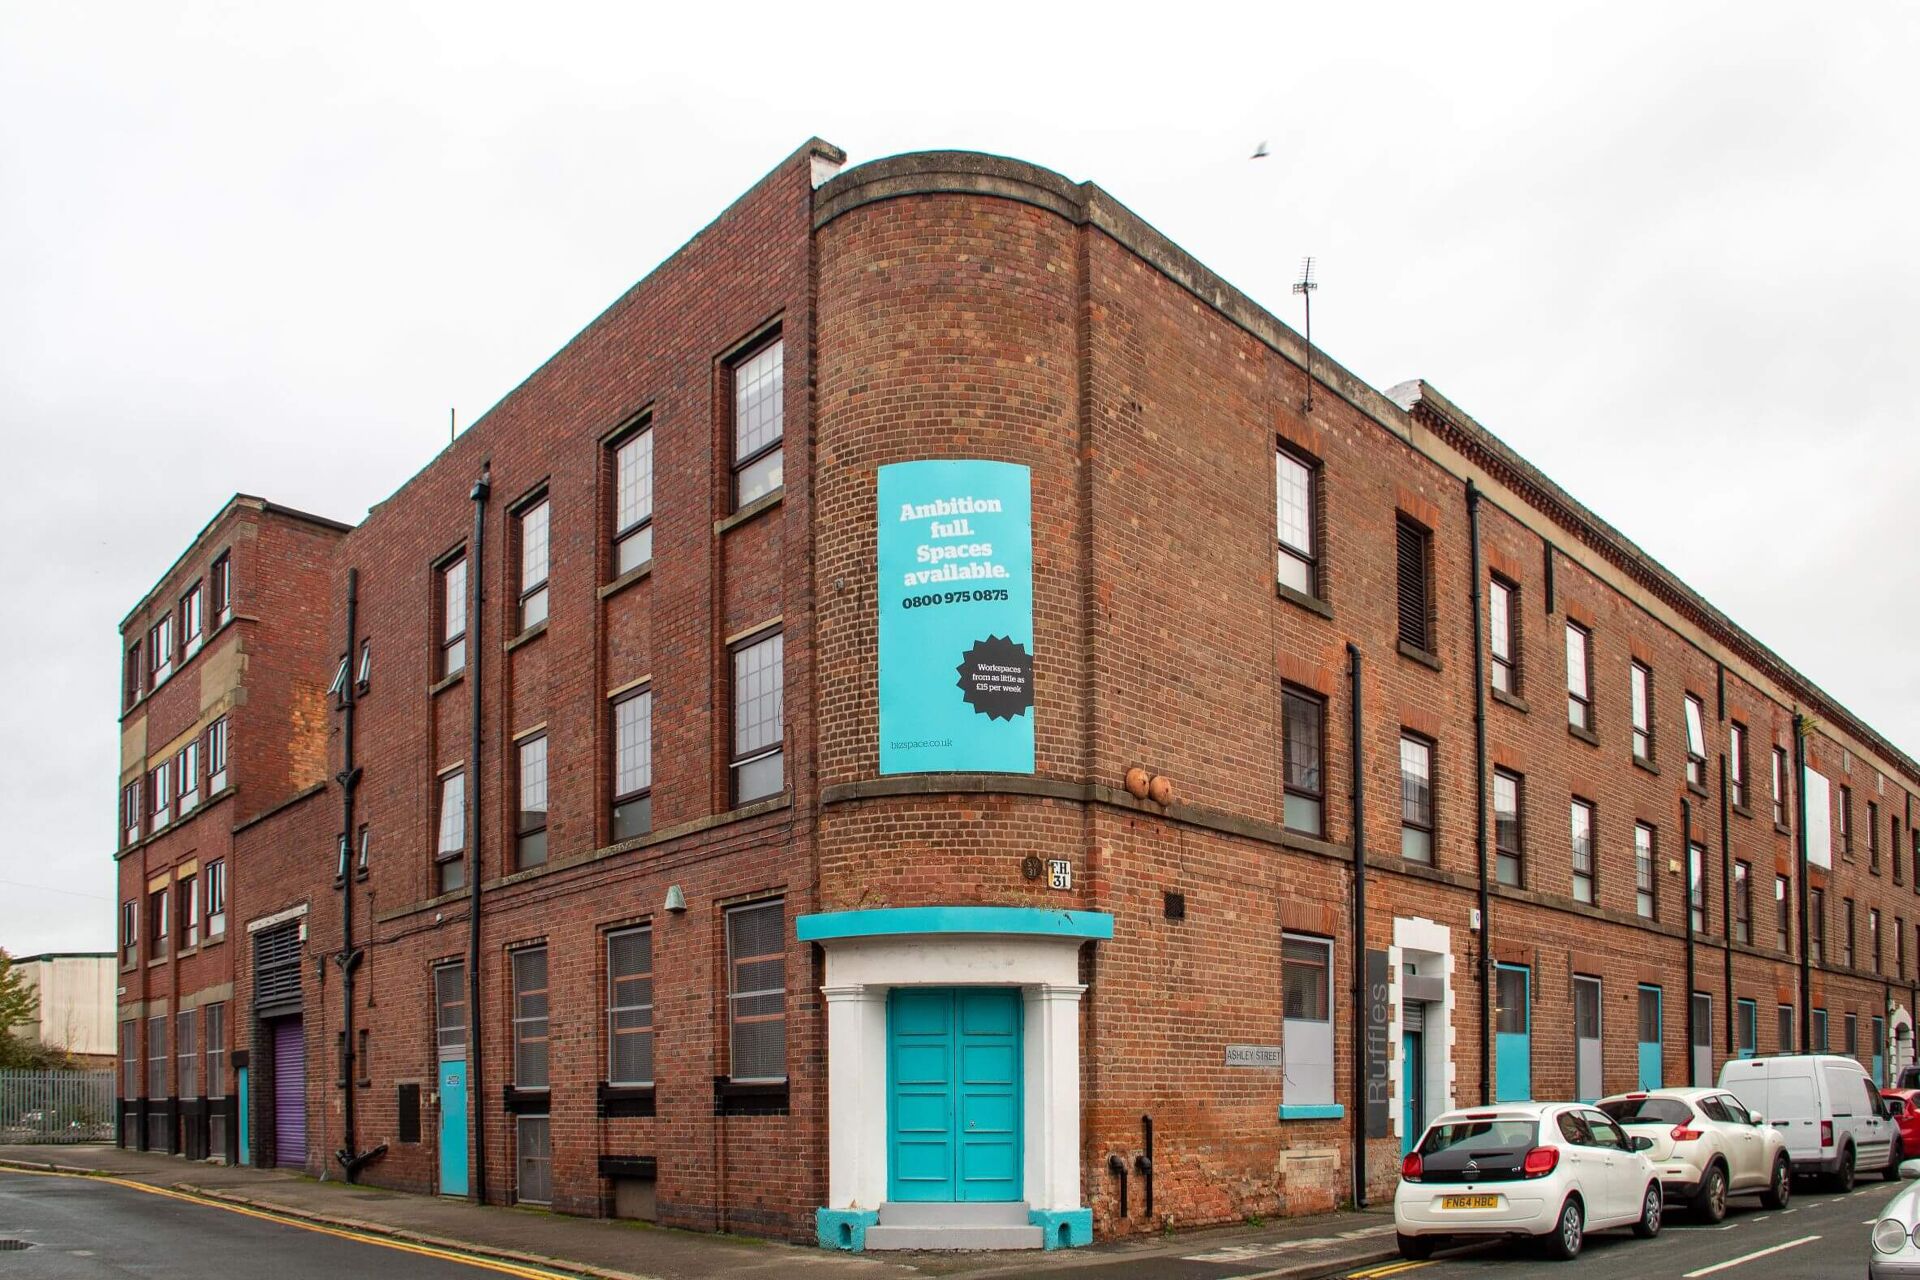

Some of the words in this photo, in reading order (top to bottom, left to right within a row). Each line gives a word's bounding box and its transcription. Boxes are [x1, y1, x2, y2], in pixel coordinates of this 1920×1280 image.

[900, 496, 1002, 521] Ambition
[931, 519, 975, 538] full.
[916, 543, 993, 563] Spaces
[904, 562, 1010, 586] available.
[902, 594, 942, 609] 0800
[944, 591, 971, 604] 975
[973, 590, 1008, 602] 0875
[978, 663, 1021, 673] Workspaces
[972, 673, 990, 681] from
[1001, 674, 1016, 682] little
[1002, 685, 1021, 693] week
[891, 739, 952, 750] bizspace.co.uk
[1053, 875, 1066, 887] 31
[1368, 983, 1387, 1104] Ruffles
[1228, 1050, 1253, 1061] ASHLEY
[1255, 1051, 1281, 1061] STREET
[1446, 1199, 1471, 1207] FN64
[1474, 1197, 1494, 1207] HBC
